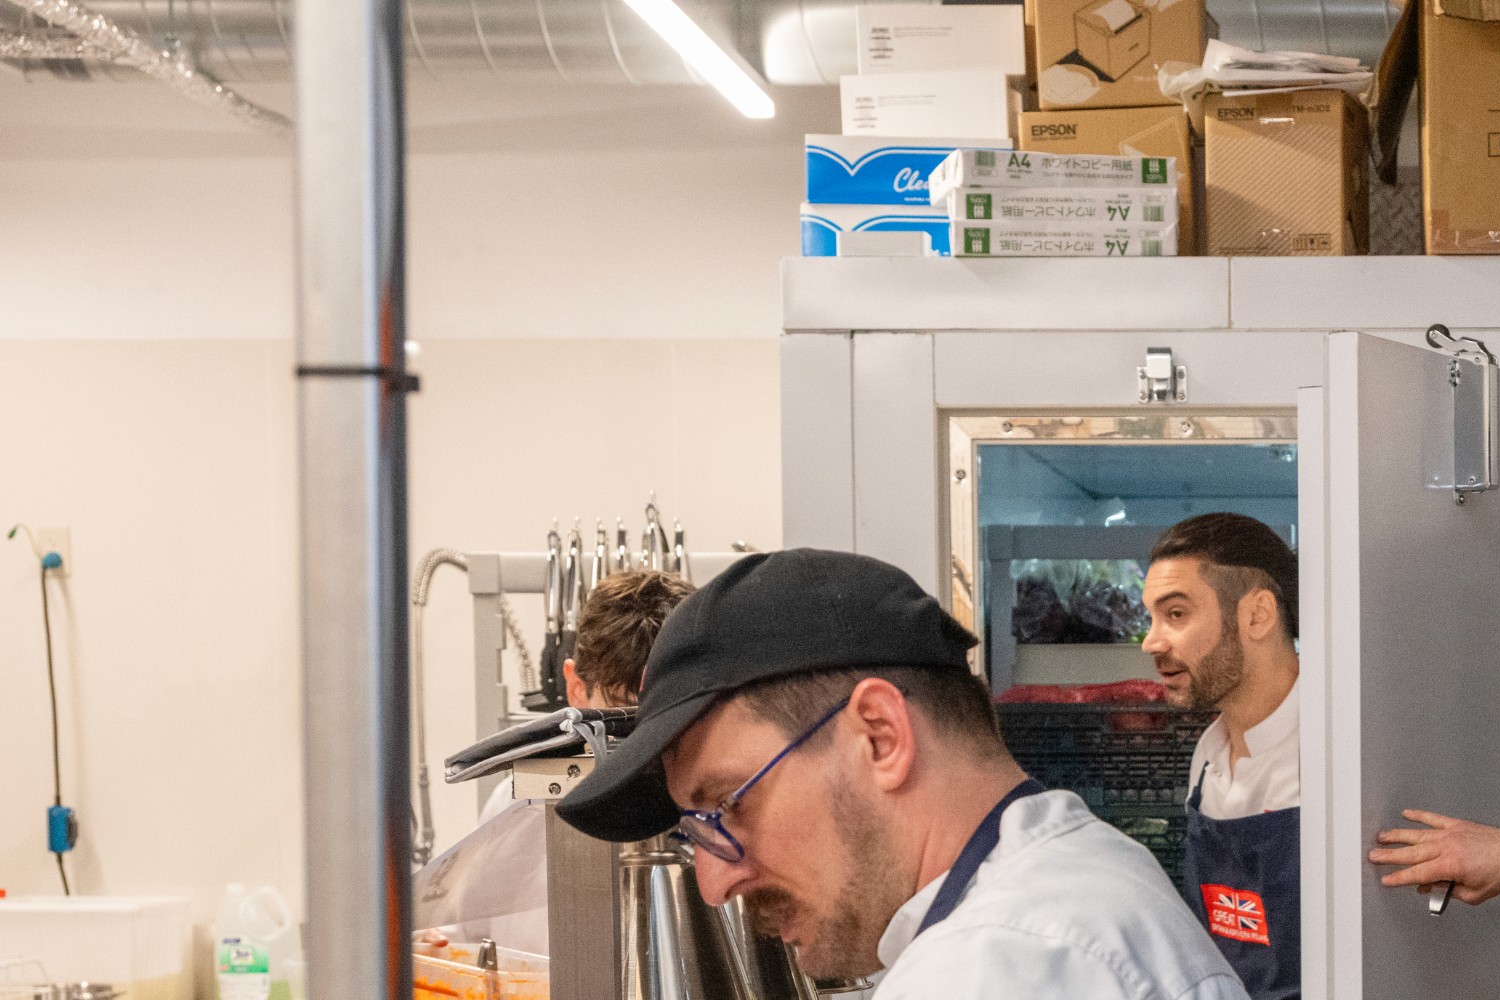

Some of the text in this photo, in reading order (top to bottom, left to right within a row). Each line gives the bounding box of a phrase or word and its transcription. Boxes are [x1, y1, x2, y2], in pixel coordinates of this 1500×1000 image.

[1217, 107, 1254, 118] EPSON
[1031, 124, 1077, 136] EPSON
[1007, 153, 1031, 168] A4
[1041, 157, 1133, 172] ホワイトコピー用紙
[1001, 205, 1096, 218] ホワイトコピー用紙
[1107, 206, 1131, 221] A4
[999, 239, 1095, 252] ホワイトコピー用紙
[1105, 240, 1129, 256] A4
